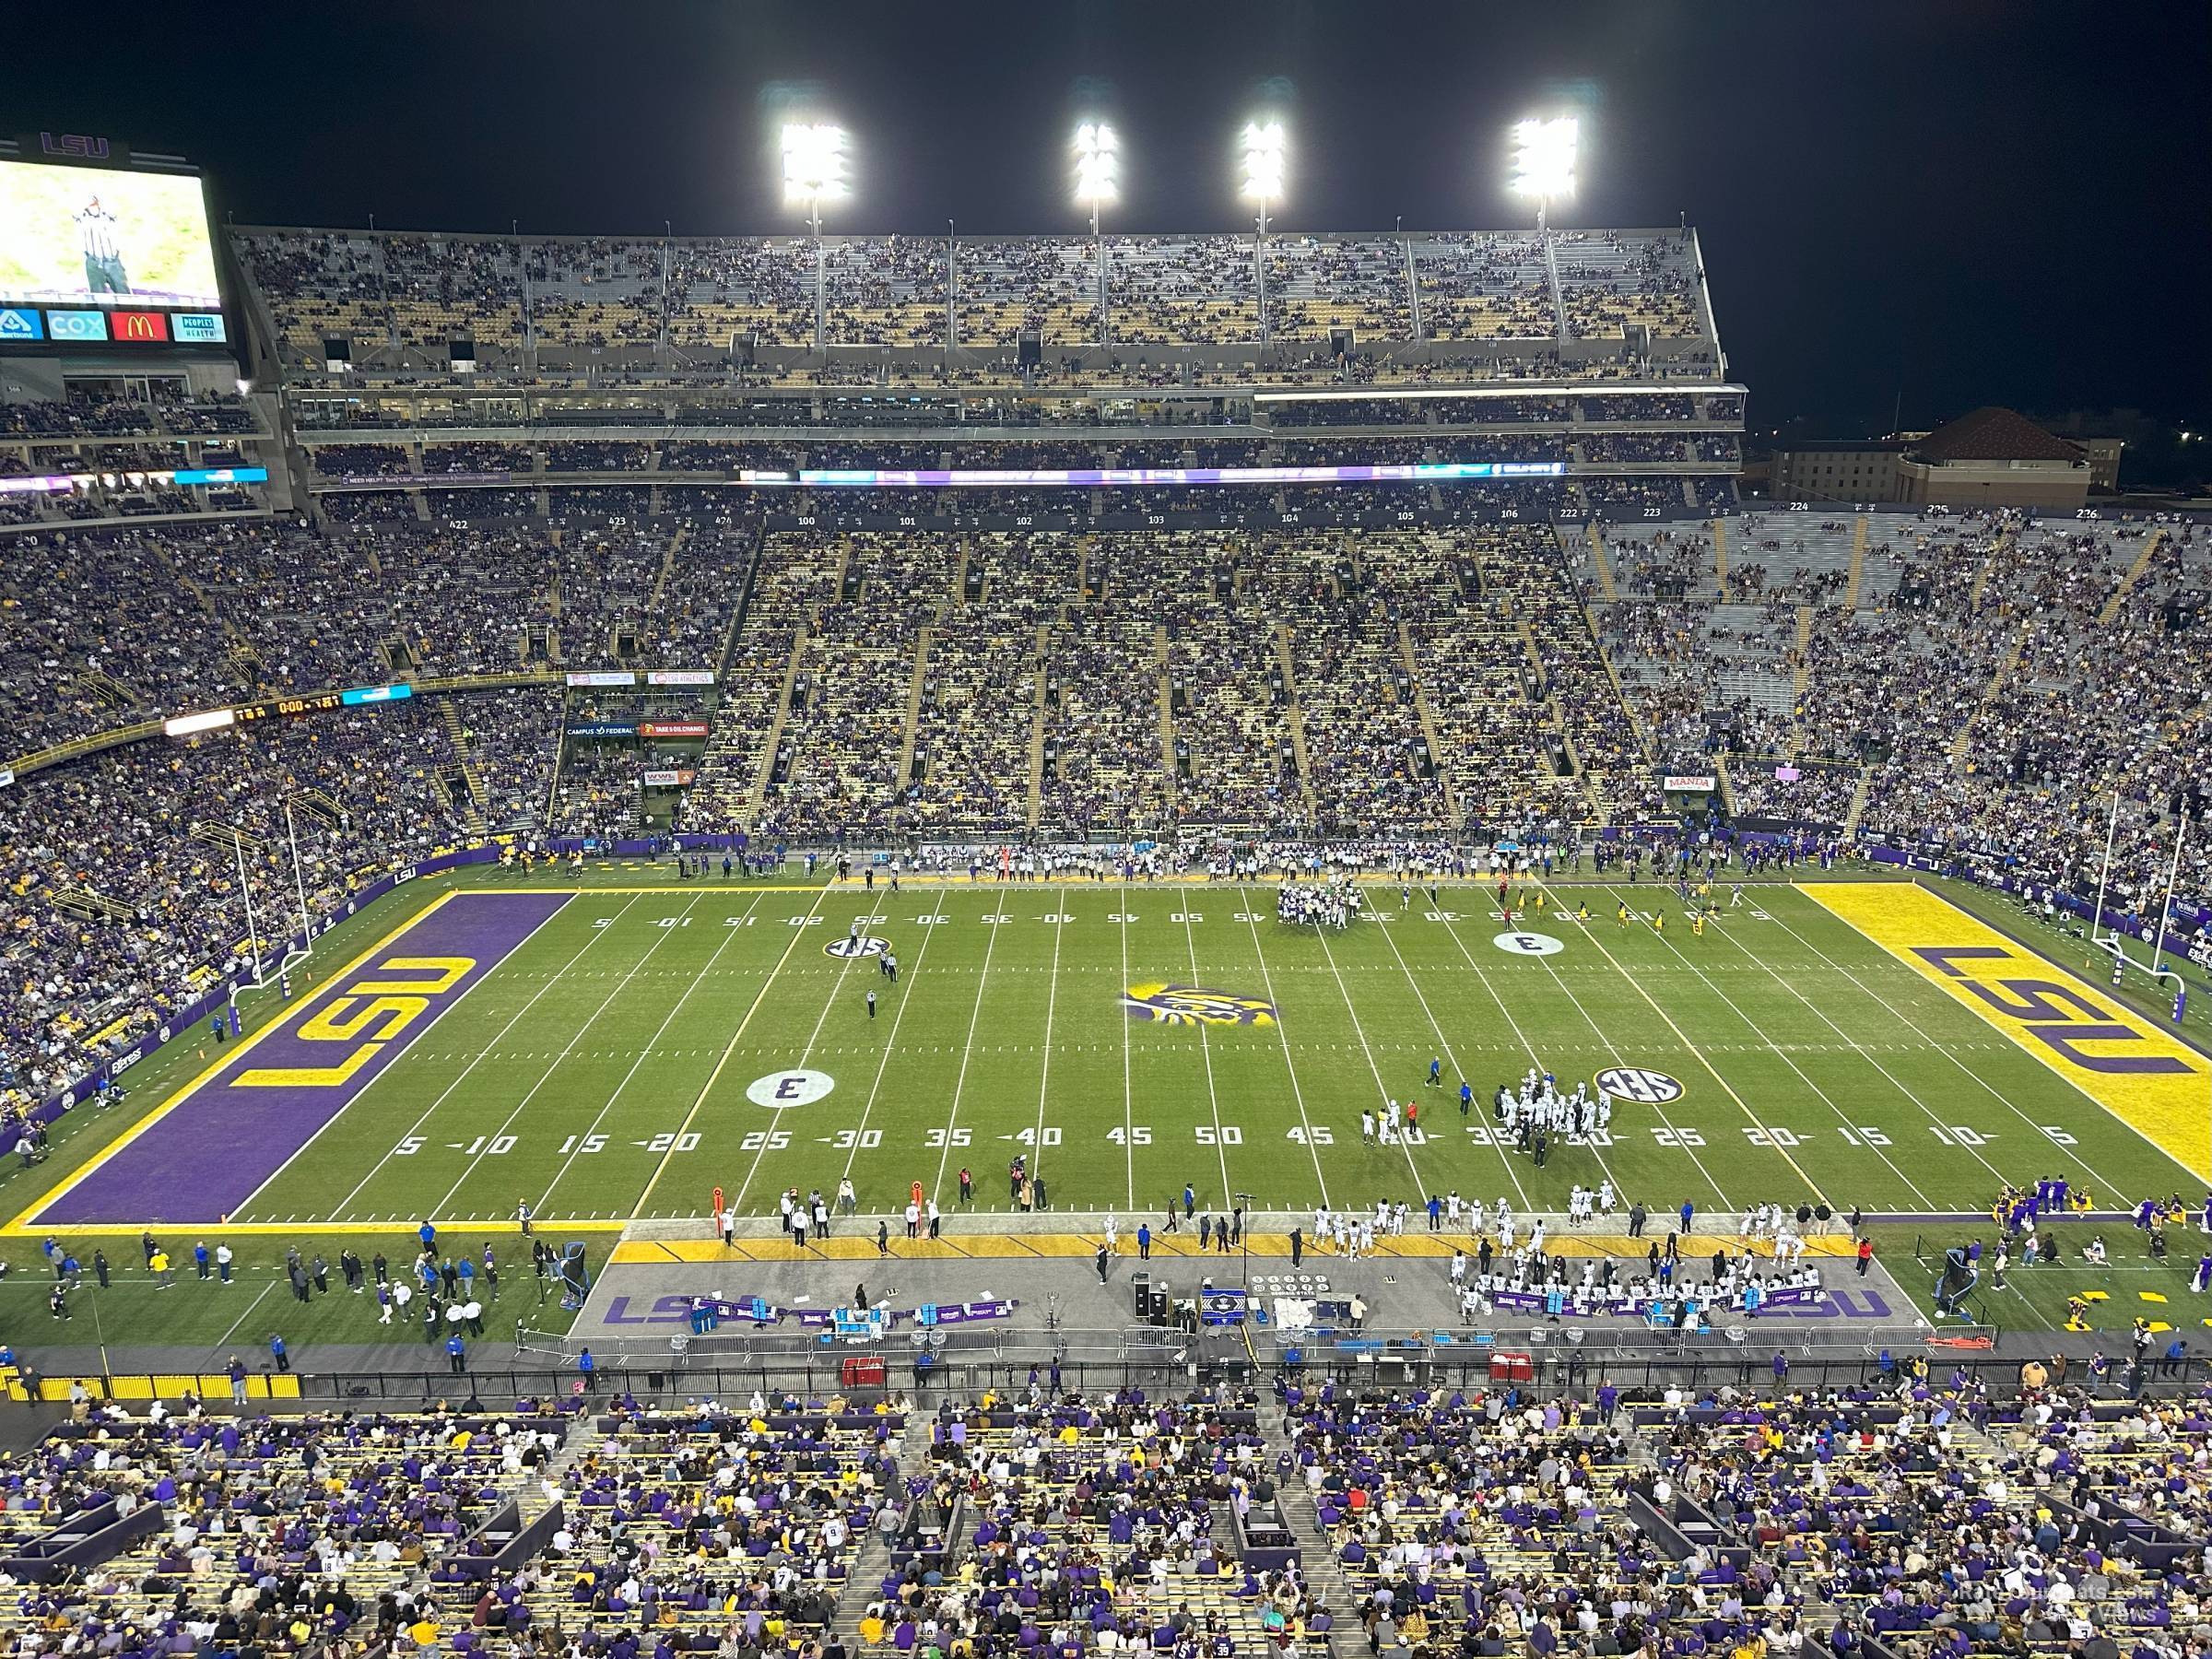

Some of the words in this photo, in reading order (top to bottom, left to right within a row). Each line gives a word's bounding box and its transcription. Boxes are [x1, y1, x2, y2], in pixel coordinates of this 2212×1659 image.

[40, 131, 111, 159] LSU
[49, 316, 103, 333] COX
[183, 318, 214, 327] PEOPLES
[185, 329, 215, 338] HEALTH
[1789, 502, 1809, 512] 224
[1397, 512, 1415, 521] 105
[1500, 509, 1518, 518] 106
[1560, 509, 1577, 518] 222
[1643, 508, 1661, 517] 223
[2076, 508, 2097, 519] 226
[608, 517, 626, 525] 423
[798, 517, 815, 526] 100
[900, 517, 916, 526] 101
[1016, 517, 1032, 525] 102
[1148, 516, 1165, 524] 103
[1281, 514, 1299, 523] 104
[449, 520, 468, 529] 422
[678, 674, 709, 683] ATHLETICS
[279, 700, 303, 714] 0:00
[1669, 778, 1710, 788] MANDA
[394, 866, 417, 885] LSU
[788, 916, 824, 925] 20
[854, 915, 888, 924] 25
[916, 915, 950, 924] 30
[980, 914, 1014, 924] 35
[1043, 914, 1077, 924] 40
[1107, 913, 1140, 923] 45
[1170, 913, 1204, 923] 50
[1234, 913, 1266, 922] 45
[1423, 912, 1461, 921] 30
[1749, 911, 1772, 920] 5
[591, 918, 613, 928] 5
[657, 918, 694, 927] 10
[723, 917, 758, 926] 15
[829, 937, 888, 958] SEC
[1907, 947, 2199, 1073] LSU
[229, 957, 477, 1087] LSU
[1601, 1069, 1677, 1101] SEC
[832, 1130, 884, 1148] 30
[924, 1129, 973, 1147] 35
[1016, 1127, 1063, 1146] 40
[1106, 1127, 1152, 1145] 45
[1195, 1127, 1243, 1145] 50
[1286, 1126, 1335, 1145] 45
[1465, 1127, 1521, 1146] 35
[1649, 1128, 1707, 1147] 25
[1741, 1128, 1800, 1146] 20
[1836, 1127, 1893, 1145] 15
[1928, 1126, 1987, 1145] 10
[2040, 1126, 2080, 1144] 5
[394, 1136, 428, 1154] 5
[465, 1135, 519, 1154] 10
[558, 1135, 610, 1153] 15
[647, 1133, 703, 1152] 20
[740, 1131, 793, 1150] 25
[830, 1529, 836, 1537] 9
[1989, 1558, 1994, 1566] 7
[325, 1563, 332, 1572] 18
[779, 1575, 785, 1583] 7
[490, 1581, 499, 1590] 18
[2082, 1629, 2088, 1638] 3
[1218, 1647, 1230, 1656] 39
